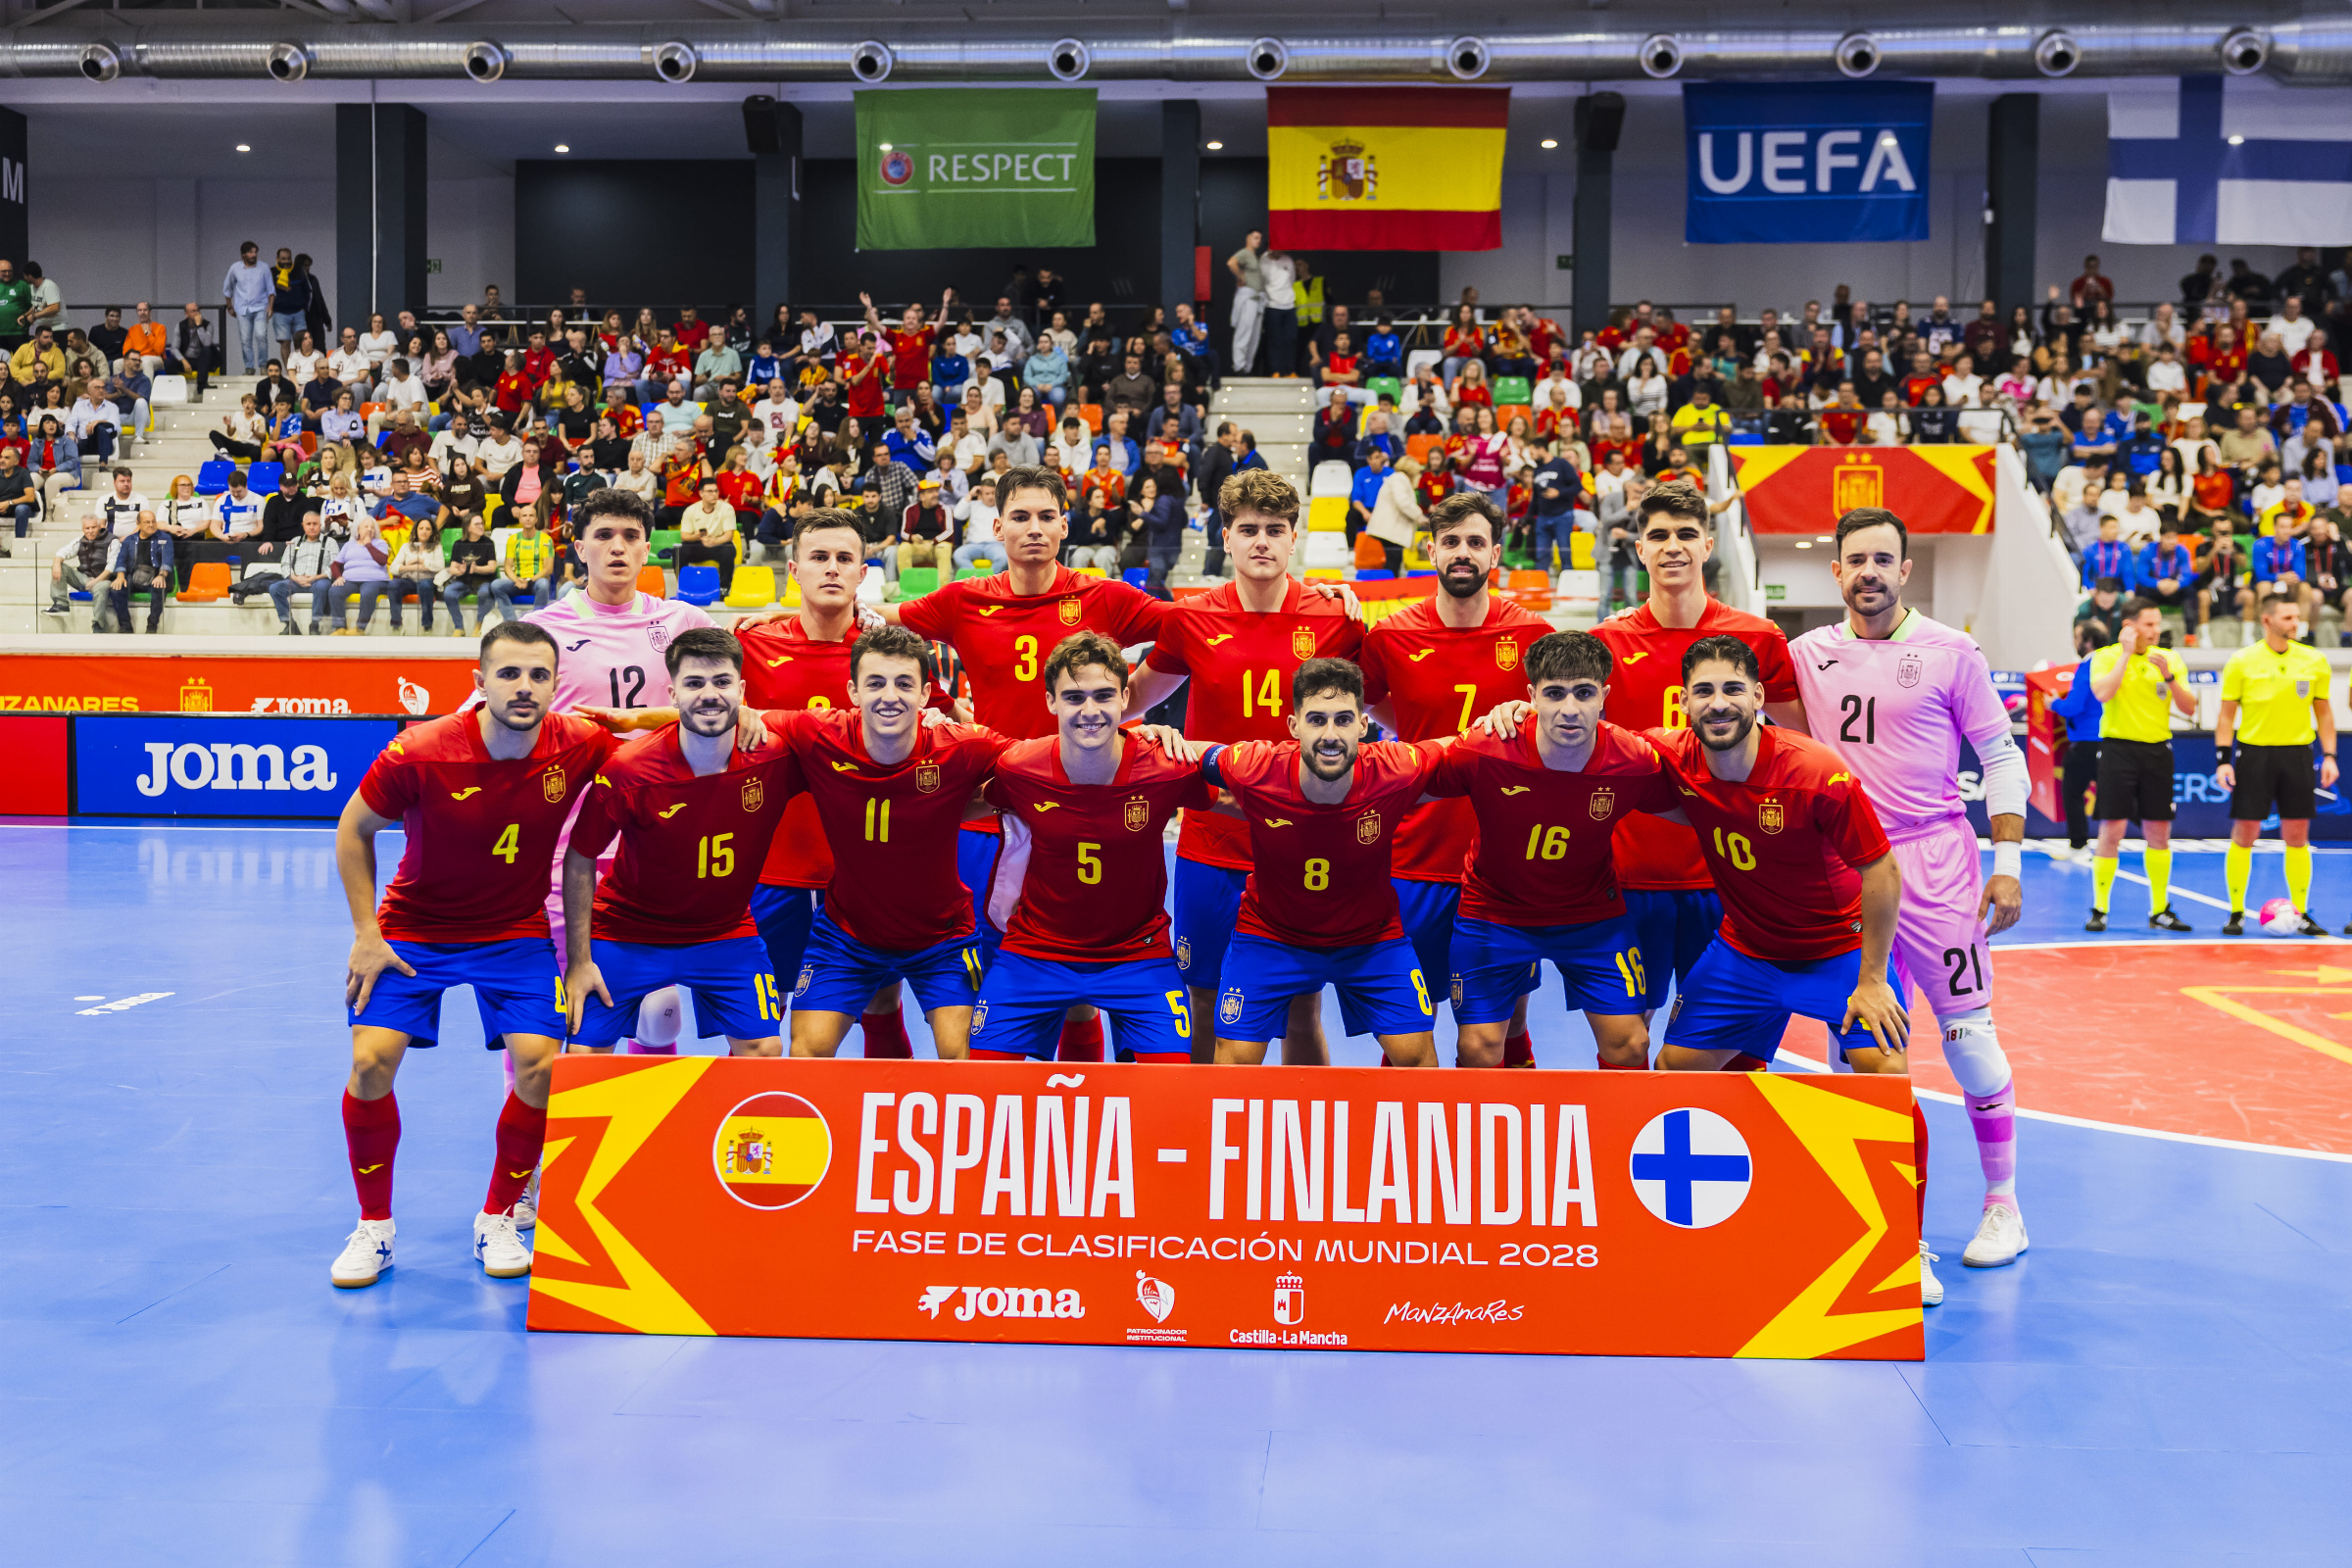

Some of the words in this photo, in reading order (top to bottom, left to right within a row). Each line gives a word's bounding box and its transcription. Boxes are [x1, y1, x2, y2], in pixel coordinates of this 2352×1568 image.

[929, 154, 1077, 181] RESPECT
[1698, 129, 1917, 194] UEFA
[1014, 634, 1039, 682] 3
[610, 665, 648, 710] 12
[1243, 668, 1284, 718] 14
[1453, 684, 1477, 732] 7
[1662, 685, 1688, 731] 6
[1839, 694, 1876, 745] 21
[864, 797, 891, 843] 11
[1525, 823, 1571, 860] 16
[492, 823, 519, 864] 4
[697, 832, 736, 879] 15
[1077, 842, 1102, 885] 5
[1712, 826, 1757, 871] 10
[1303, 858, 1331, 892] 8
[961, 948, 984, 992] 11
[1409, 968, 1433, 1016] 8
[1614, 946, 1646, 998] 16
[1942, 942, 1984, 997] 21
[754, 973, 781, 1021] 15
[1164, 990, 1191, 1038] 5
[855, 1073, 1136, 1218] ESPAÑA
[1157, 1149, 1188, 1163] -
[1208, 1098, 1598, 1227] FINLANDIA
[853, 1230, 947, 1254] FASE
[957, 1232, 1007, 1255] DE
[1017, 1231, 1302, 1261] CLASIFICACIÓN
[1314, 1239, 1489, 1265] MUNDIAL
[1498, 1244, 1599, 1268] 2028
[1298, 1330, 1348, 1346] Mancha
